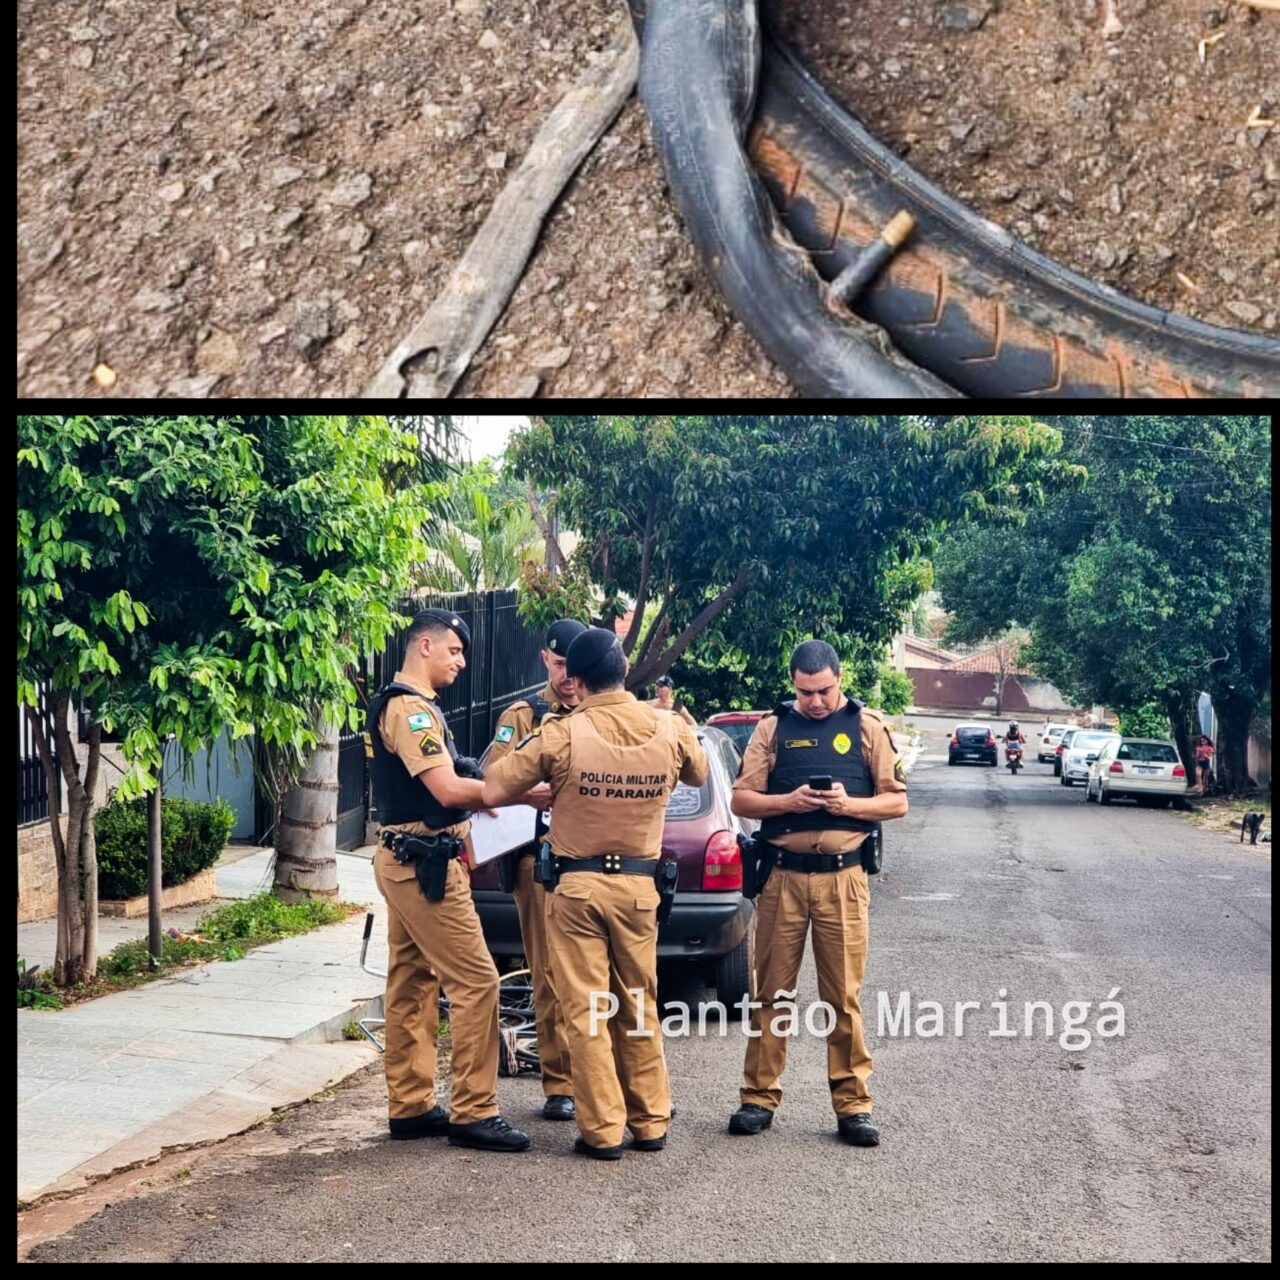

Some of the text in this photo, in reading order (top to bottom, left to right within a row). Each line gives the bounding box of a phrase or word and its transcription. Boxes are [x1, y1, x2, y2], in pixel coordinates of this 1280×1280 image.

[580, 771, 667, 785] POLÍCIA MILITAR
[579, 786, 600, 797] DO
